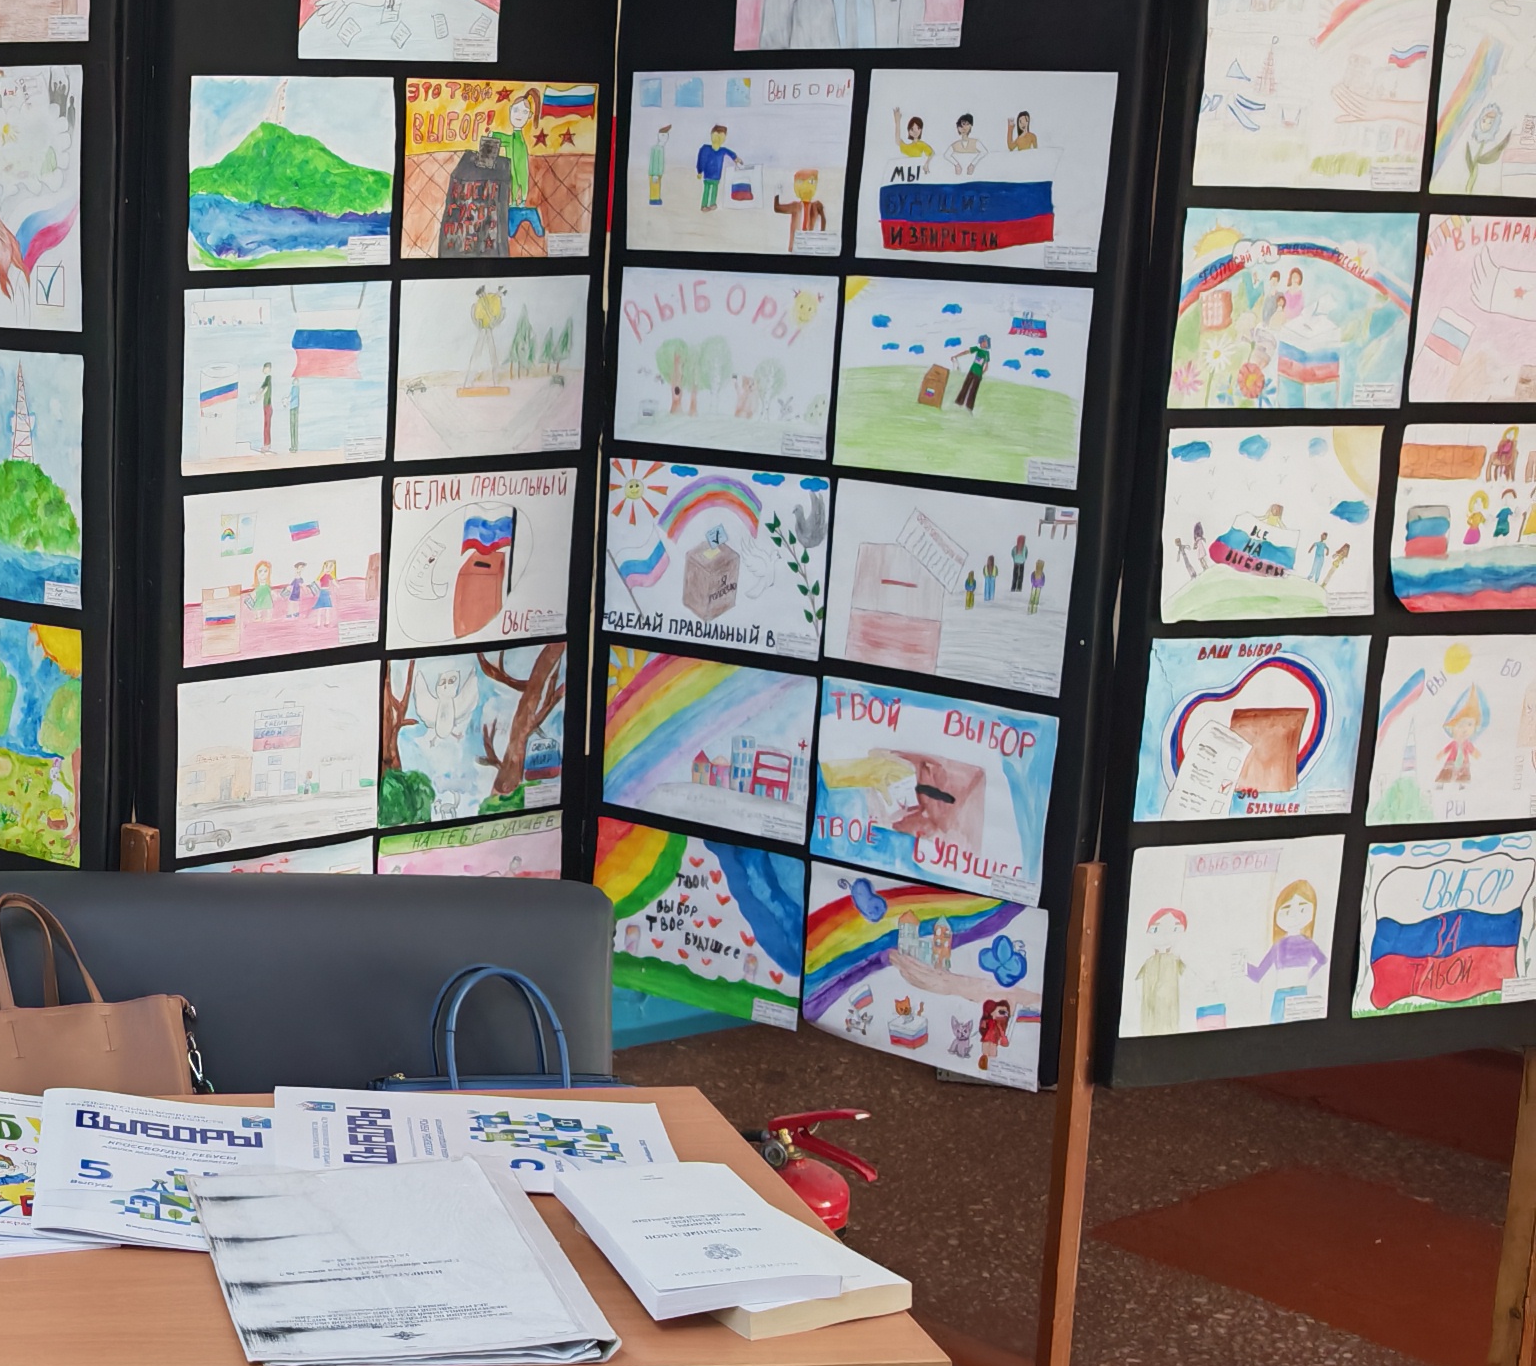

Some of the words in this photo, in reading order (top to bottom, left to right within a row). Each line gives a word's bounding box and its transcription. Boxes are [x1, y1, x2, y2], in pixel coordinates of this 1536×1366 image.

[407, 82, 442, 103] ЭТО
[413, 110, 497, 144] ВЫБОР!
[890, 166, 921, 182] МЫ
[1452, 222, 1536, 251] ВЫБИРА
[624, 280, 801, 346] ВЫБОРЫ
[471, 472, 567, 497] ПРАВИЛЬНЫЙ
[1250, 526, 1268, 541] ВСЕ
[1244, 541, 1262, 555] НА
[669, 619, 761, 646] ПРАВИЛЬНЫЙ
[1197, 644, 1232, 661] ВАШ
[1238, 643, 1282, 658] ВЫБОР
[1500, 658, 1522, 678] БО
[1425, 671, 1448, 696] ВЫ
[829, 691, 902, 731] ТВОЙ
[942, 709, 1036, 758] ВЫБОР
[1238, 789, 1259, 800] ЭТО
[1246, 801, 1300, 814] БУДУЩЕЕ
[413, 835, 430, 850] НА
[438, 826, 483, 847] ТЕБЕ
[817, 813, 879, 845] ТВОЁ
[1195, 855, 1270, 874] ВЫБОРЫ
[1422, 868, 1514, 911] ВЫБОР
[1436, 914, 1463, 957] ЗА
[78, 1159, 113, 1180] 5
